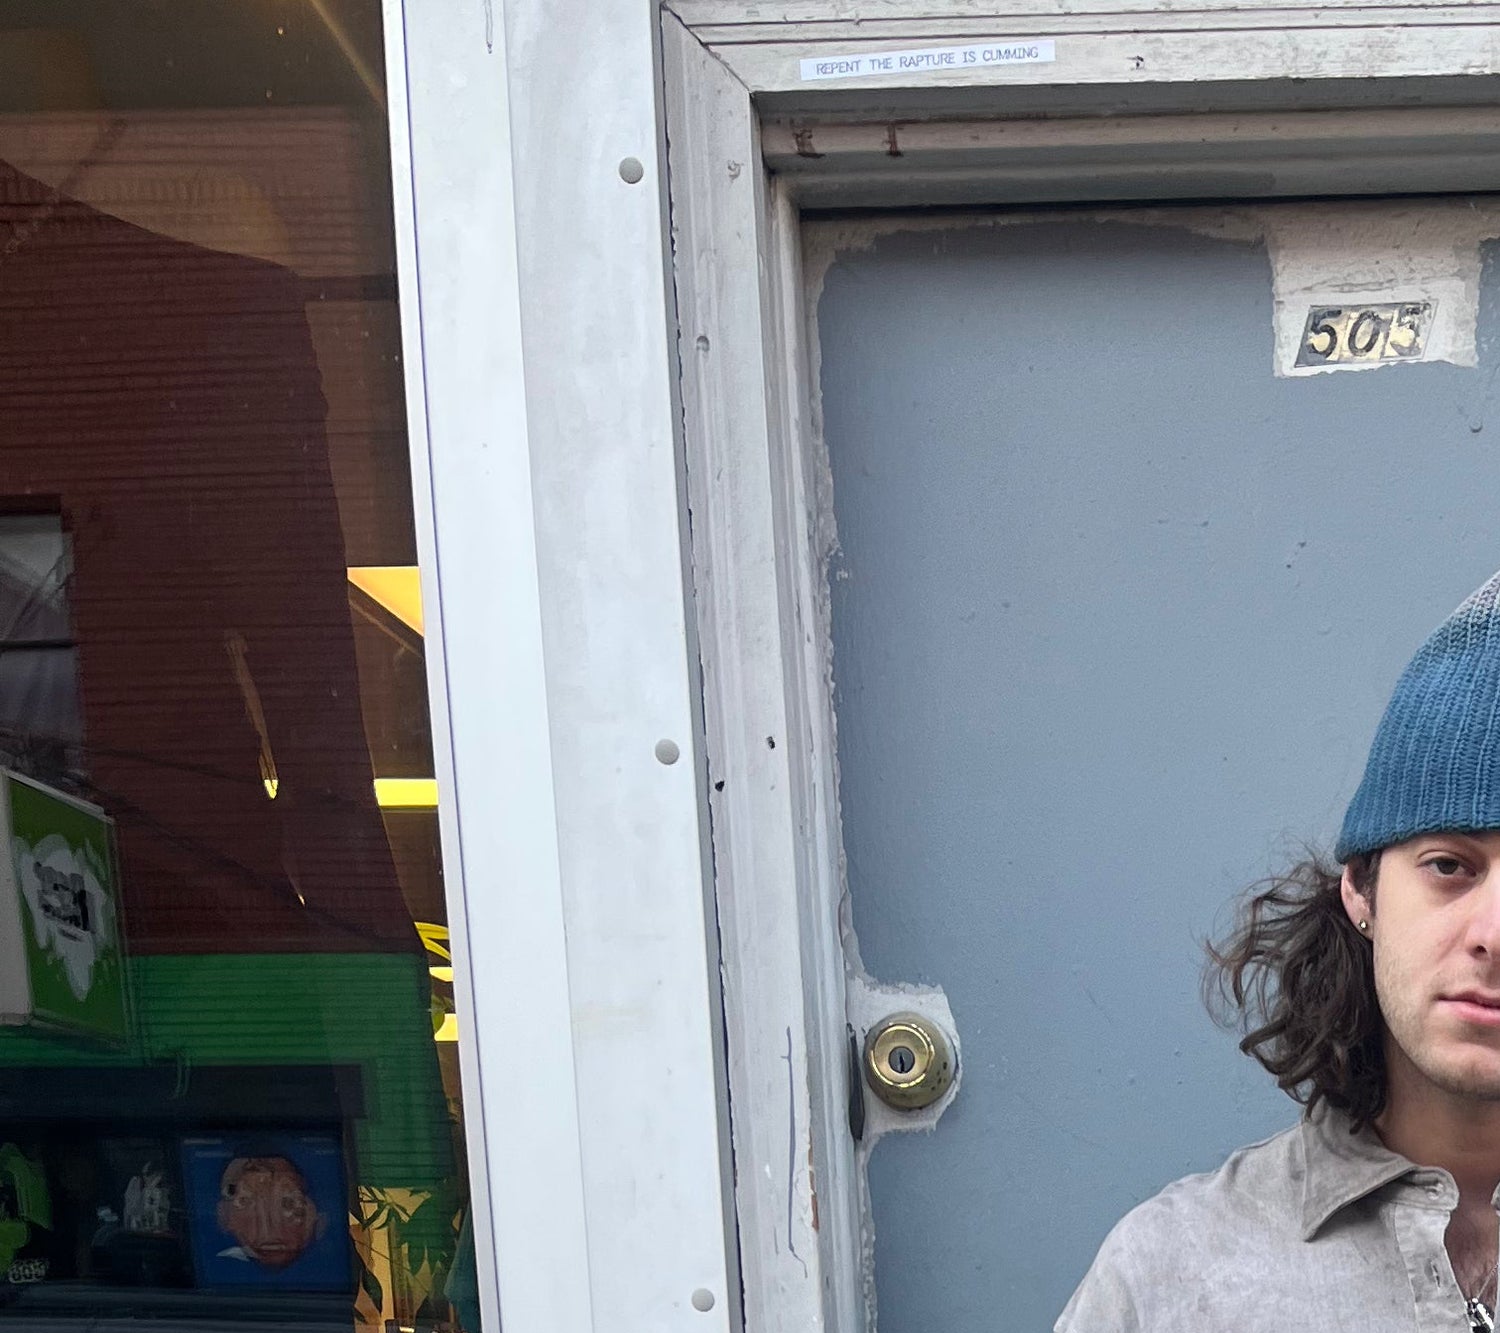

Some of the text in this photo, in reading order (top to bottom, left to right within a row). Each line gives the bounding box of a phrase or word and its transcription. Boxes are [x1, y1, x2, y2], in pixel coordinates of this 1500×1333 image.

[816, 46, 1039, 75] REPENT THE RAPTURE IS CUMMING
